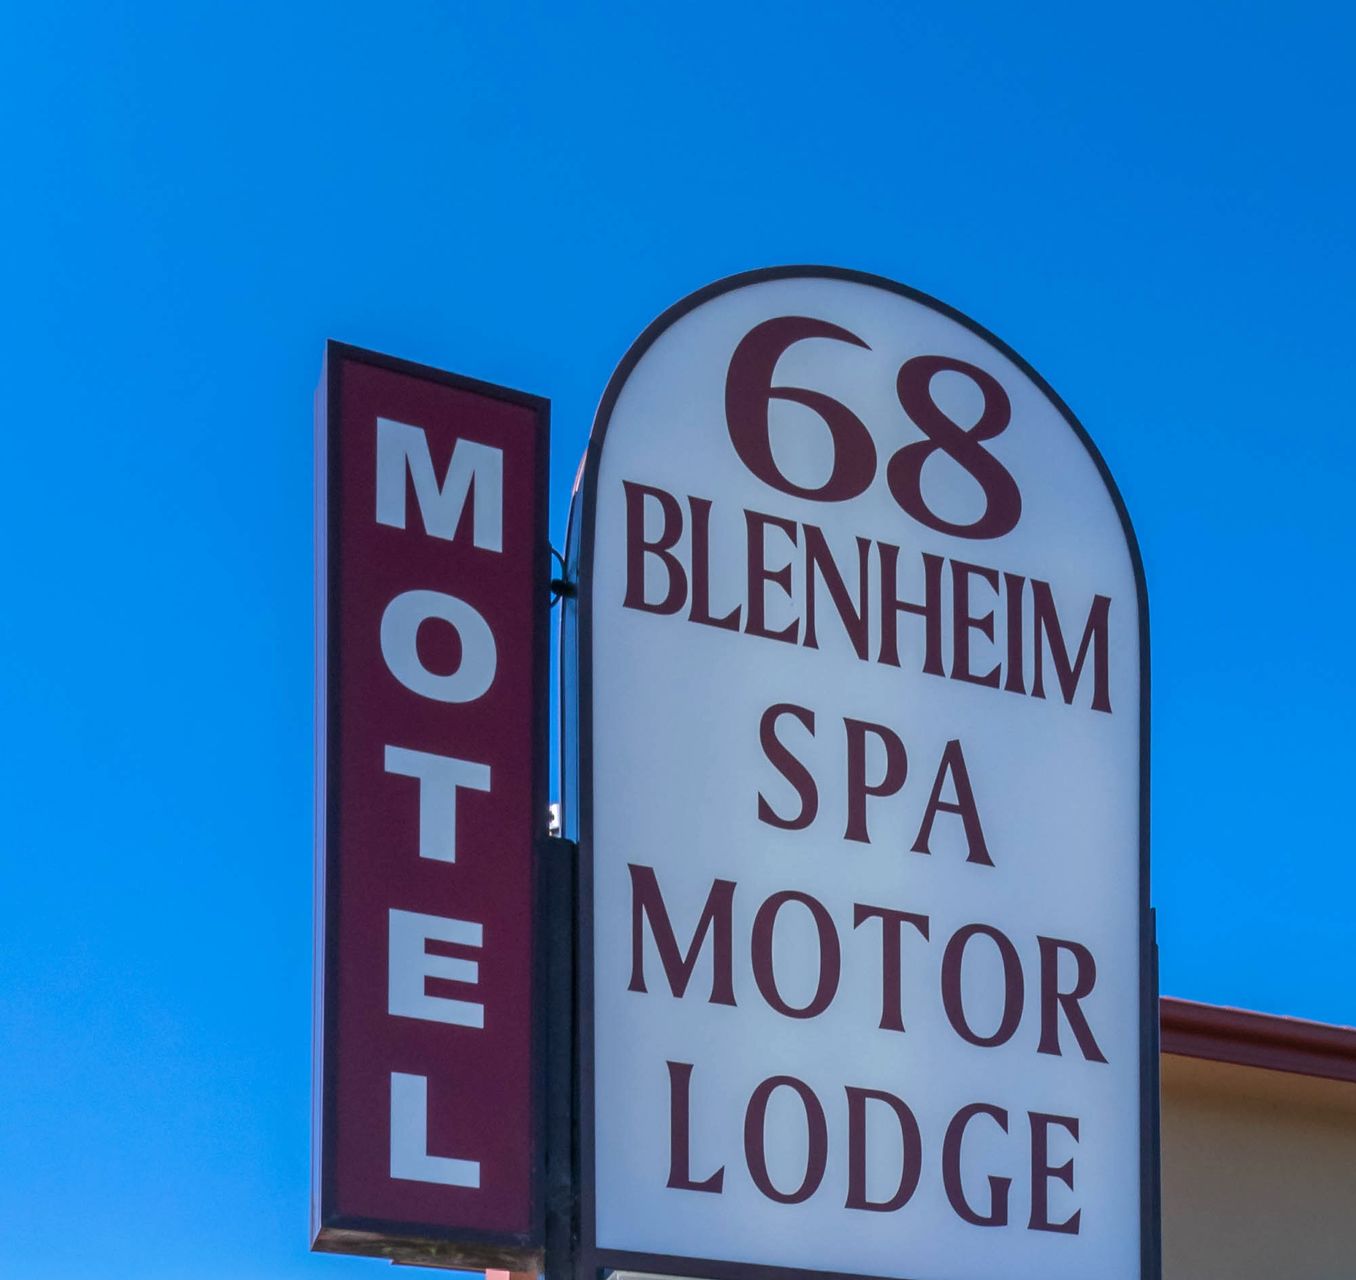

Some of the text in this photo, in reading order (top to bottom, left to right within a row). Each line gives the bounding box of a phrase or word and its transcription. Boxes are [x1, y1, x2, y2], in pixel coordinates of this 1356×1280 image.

[725, 316, 1022, 540] 68
[622, 480, 1112, 714] BLENHEIM
[377, 418, 502, 1188] MOTEL
[758, 704, 995, 867] SPA
[627, 863, 1109, 1064] MOTOR
[666, 1061, 1081, 1235] LODGE
